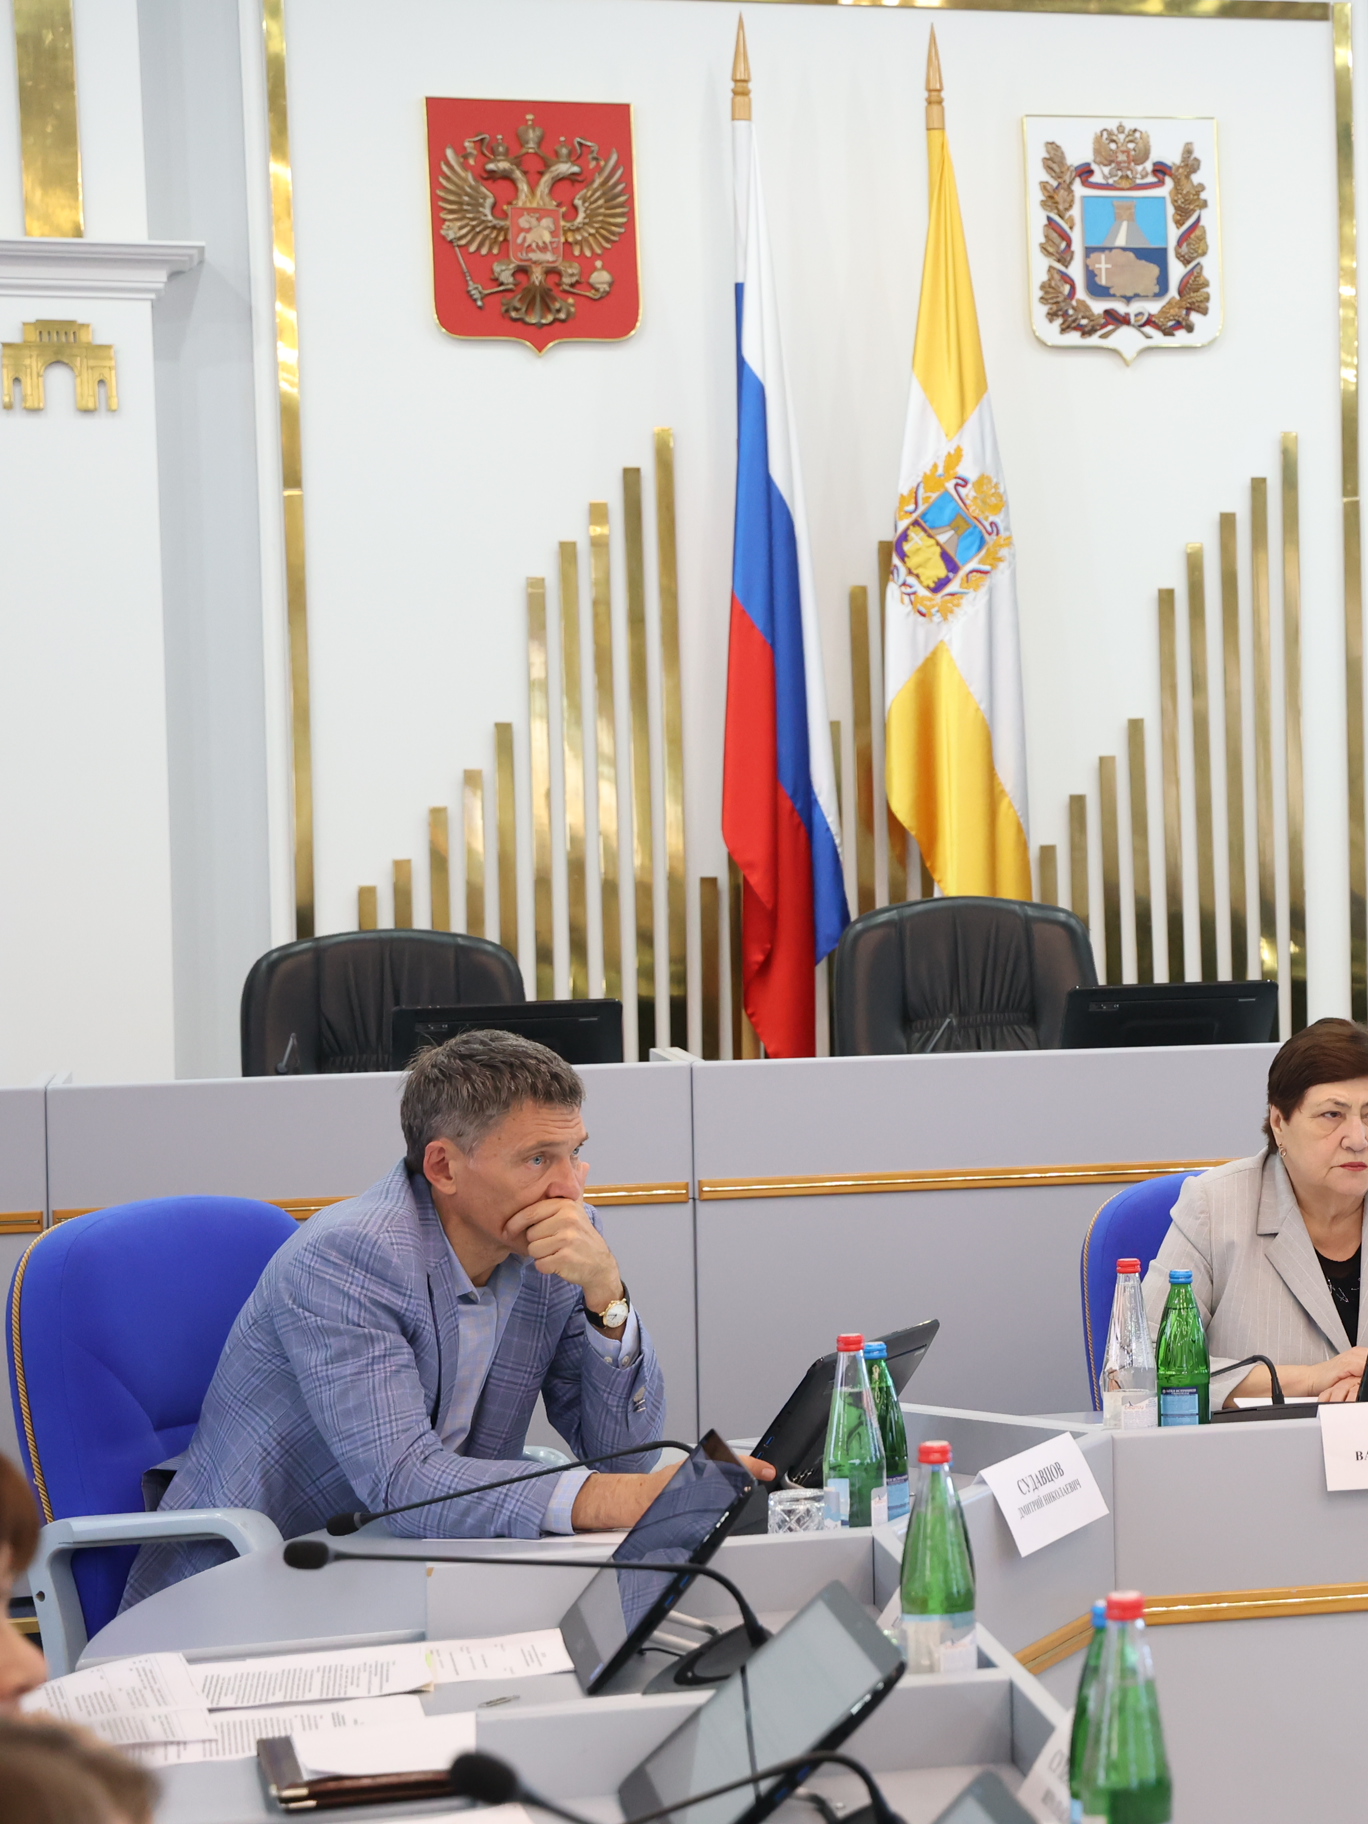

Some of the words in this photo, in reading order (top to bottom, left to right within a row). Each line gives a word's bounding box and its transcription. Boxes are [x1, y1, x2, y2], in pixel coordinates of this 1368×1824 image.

[1016, 1461, 1065, 1496] СУДАВЦОВ
[1018, 1495, 1045, 1520] ДМИТРИЙ
[1042, 1478, 1082, 1506] НИКОЛАЕВИЧ
